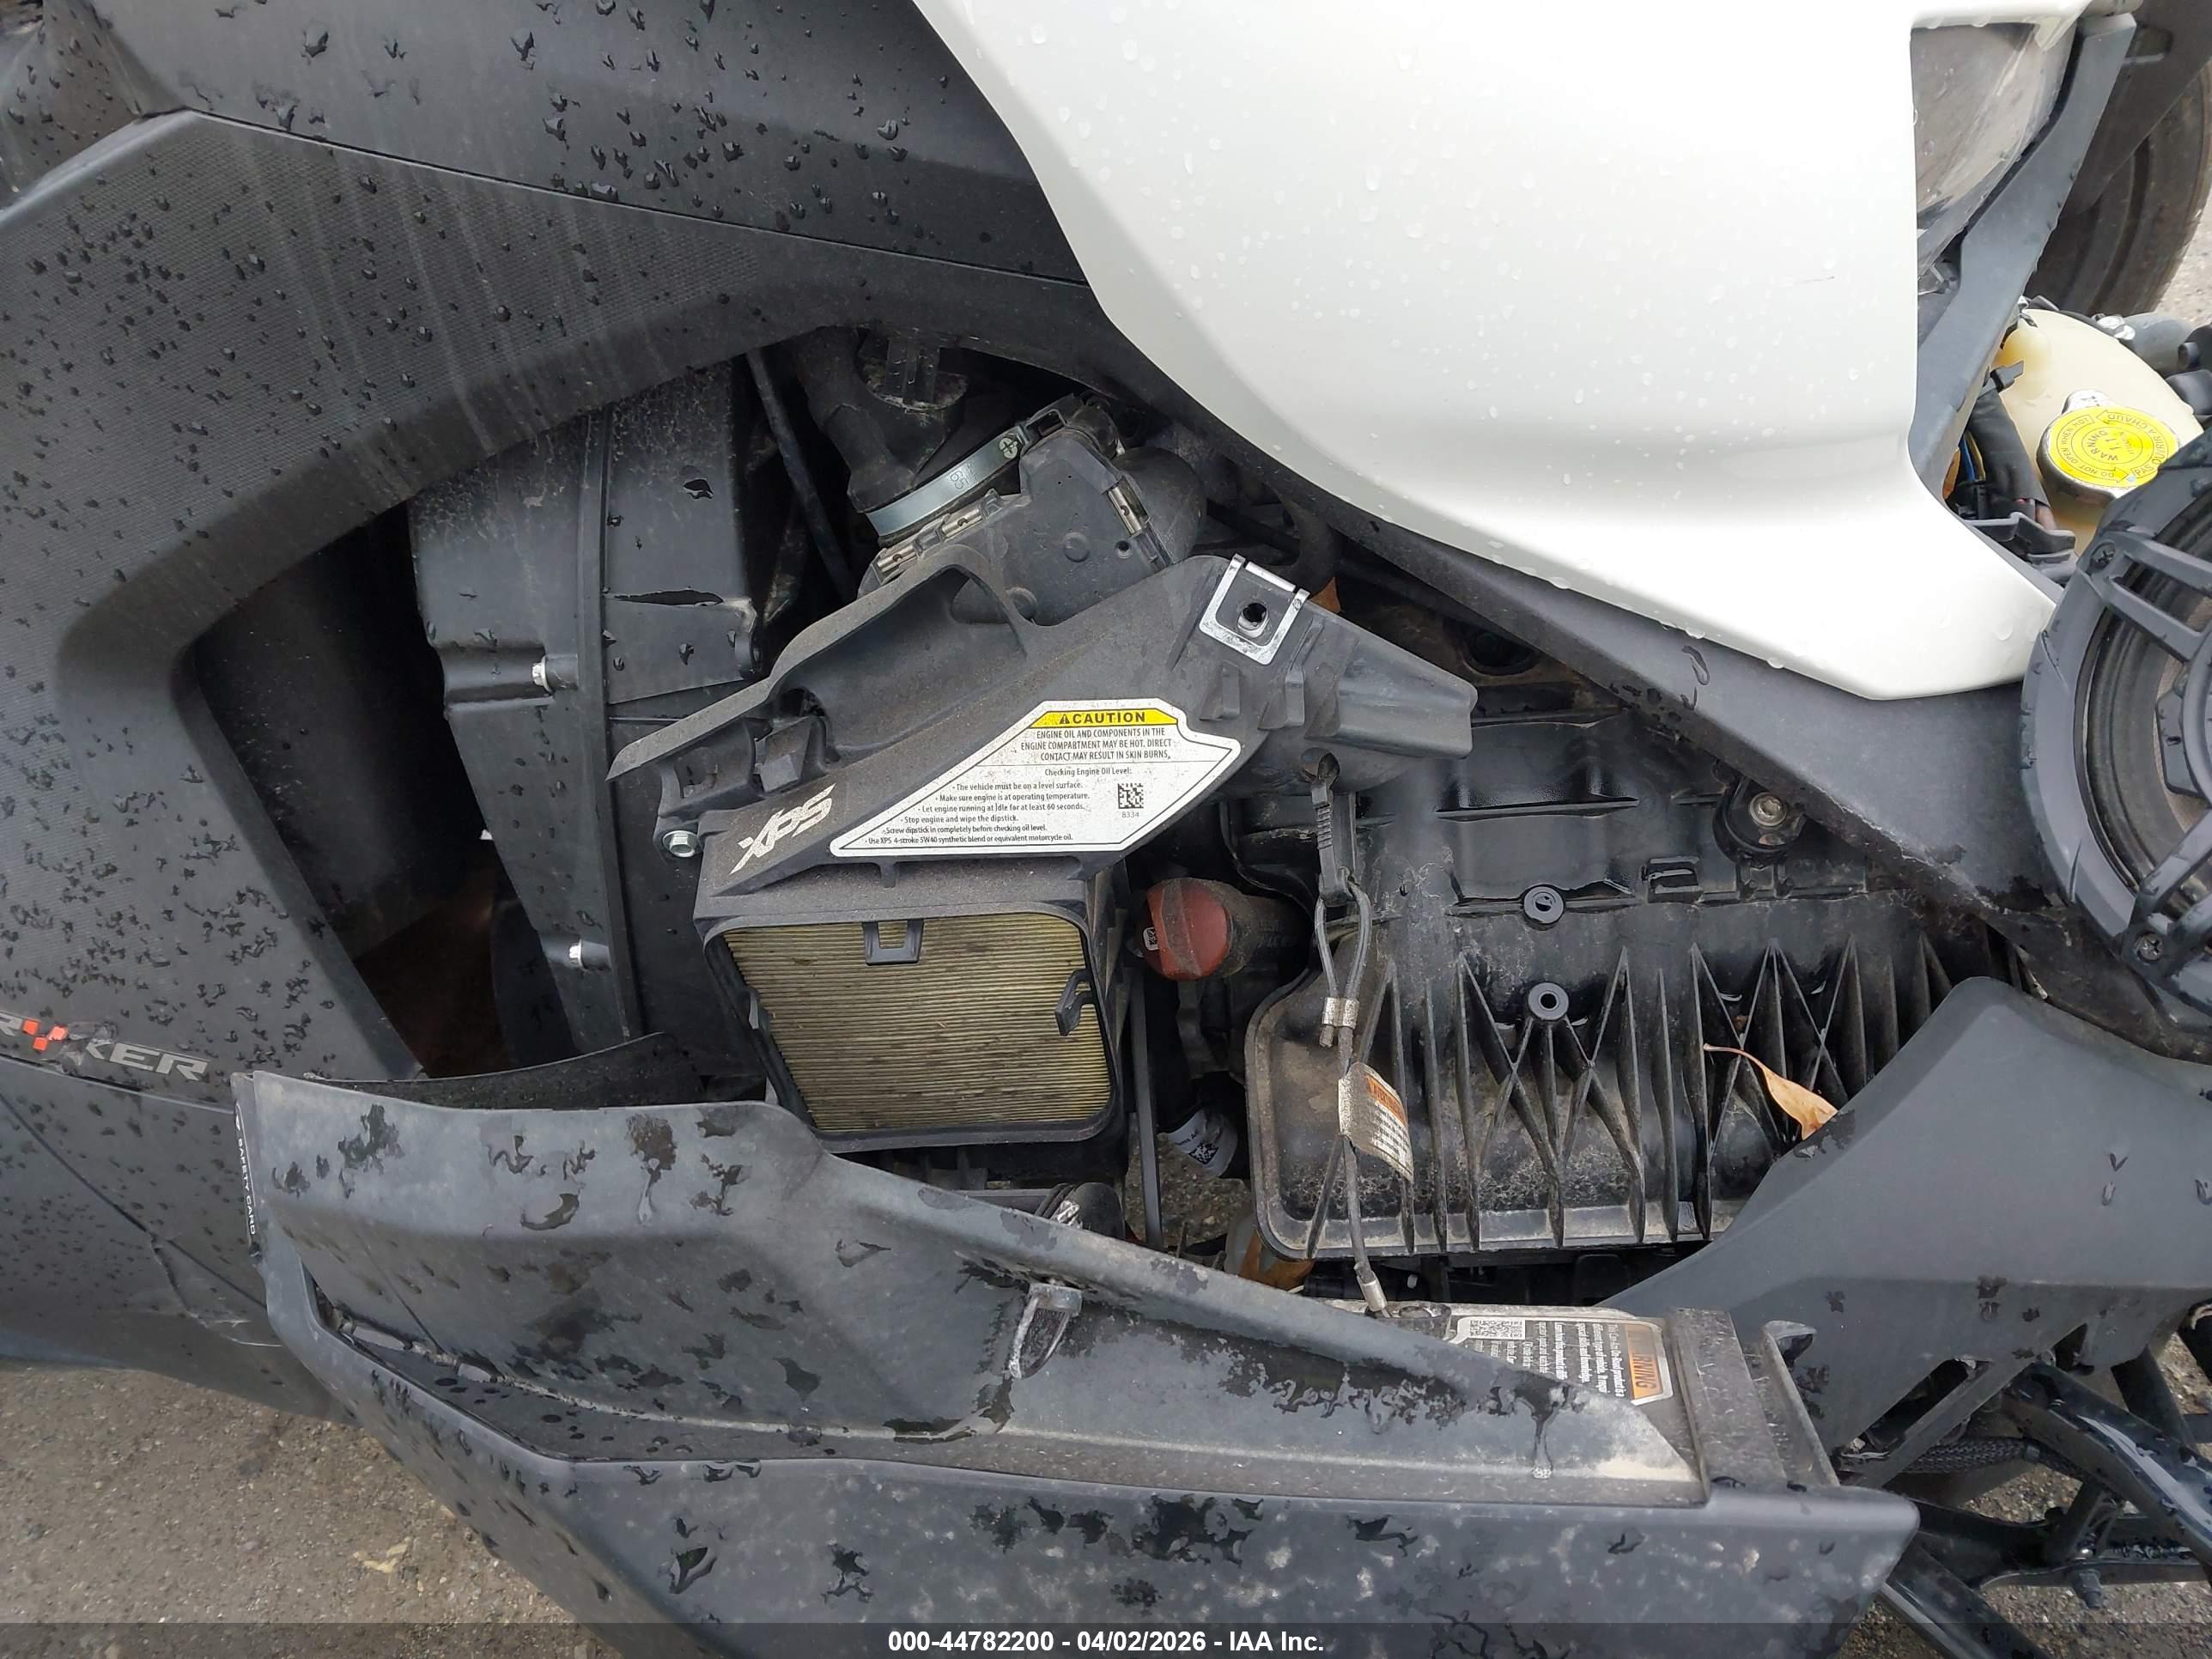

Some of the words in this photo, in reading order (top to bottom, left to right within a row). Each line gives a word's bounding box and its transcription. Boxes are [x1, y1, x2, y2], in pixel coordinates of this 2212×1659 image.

[2072, 417, 2090, 427] HOT
[2107, 414, 2148, 428] CHAUD
[2061, 428, 2073, 445] WHEN
[2087, 430, 2118, 460] WARNING
[2061, 447, 2078, 464] OPEN
[2079, 465, 2098, 474] NOT
[2134, 464, 2154, 476] PAS
[1073, 712, 1145, 724] CAUTION
[1036, 730, 1062, 739] ENGINE
[1064, 730, 1075, 738] OIL
[1077, 729, 1092, 738] AND
[1093, 728, 1140, 738] COMPONENTS
[1142, 728, 1151, 737] IN
[1021, 742, 1046, 750] ENGINE
[1048, 740, 1101, 750] COMPARTMENT
[1103, 740, 1116, 749] MAY
[1130, 738, 1146, 748] HOT.
[1147, 738, 1171, 747] DIRECT
[1041, 752, 1071, 762] CONTACT
[1073, 751, 1087, 760] MAY
[1089, 750, 1115, 760] RESULT
[1116, 750, 1124, 759] IN
[1126, 750, 1142, 759] SKIN
[1012, 793, 1044, 802] operating
[934, 805, 957, 814] engine
[958, 805, 986, 813] running
[921, 816, 945, 824] engine
[991, 815, 1018, 823] dipstick.
[729, 782, 836, 875] XPS
[994, 824, 1021, 833] checking
[994, 835, 1027, 843] equivalent
[239, 1139, 249, 1191] SAFETY
[246, 1194, 256, 1235] CARD
[1611, 1350, 1624, 1370] On-Road
[1632, 1342, 1656, 1389] RNING
[1610, 1369, 1626, 1389] product
